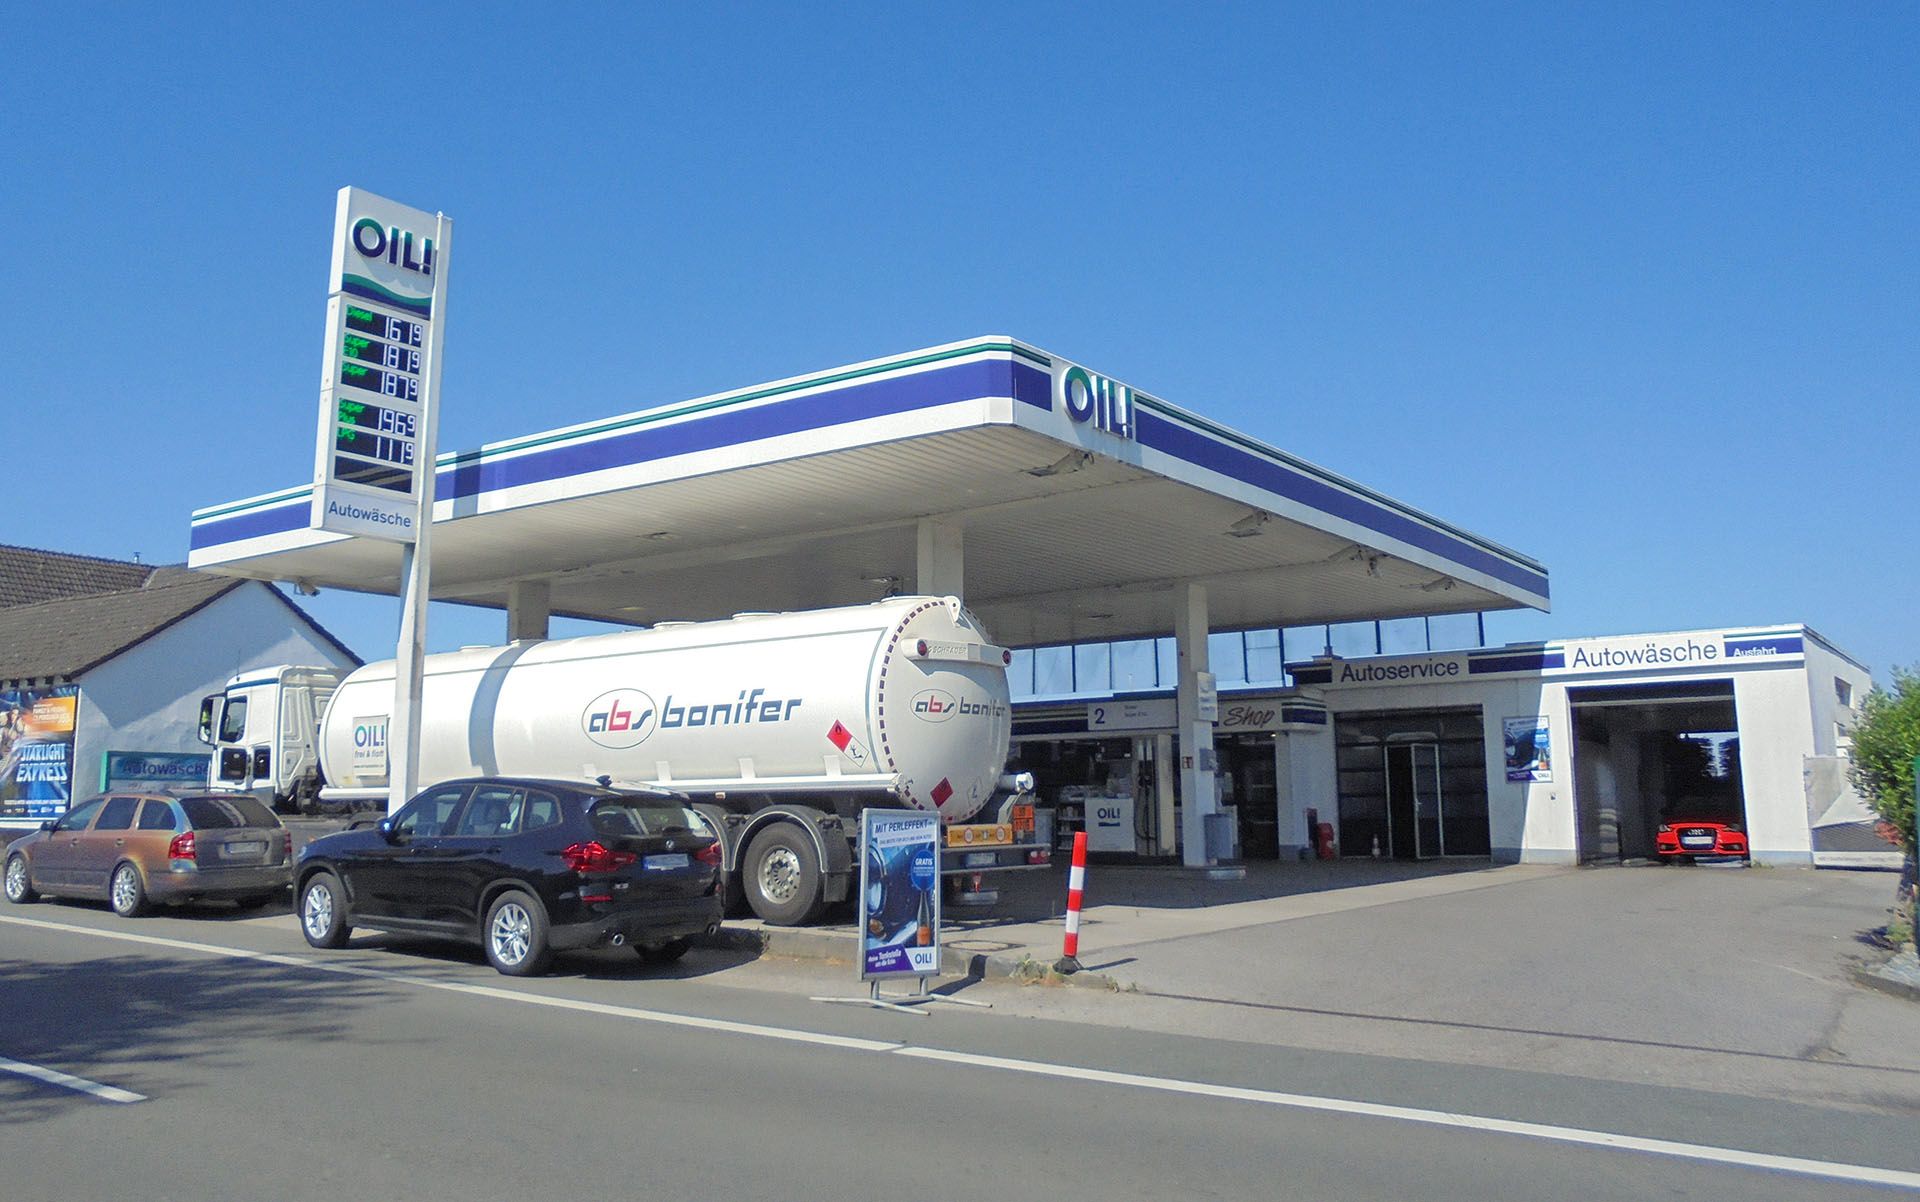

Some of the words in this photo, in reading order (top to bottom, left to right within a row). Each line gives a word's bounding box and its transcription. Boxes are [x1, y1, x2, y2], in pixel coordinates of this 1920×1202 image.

[352, 217, 433, 275] OIL!
[381, 371, 418, 399] 1879
[1060, 366, 1133, 439] OIL!
[378, 403, 416, 435] 1969
[328, 500, 412, 528] Autowäsche
[1572, 639, 1718, 668] Autowäsche
[1733, 646, 1777, 657] Ausfahrt
[1340, 658, 1460, 682] Autoservice
[588, 699, 653, 732] abs
[660, 688, 803, 728] bonifer
[1094, 707, 1106, 725] 2
[1223, 706, 1276, 729] Shop
[354, 725, 385, 748] OIL!
[20, 743, 66, 762] STARLIGHT
[16, 762, 68, 783] EXPRESS
[1097, 807, 1121, 819] OIL!
[874, 823, 888, 834] MIT
[914, 953, 932, 965] OIL!
